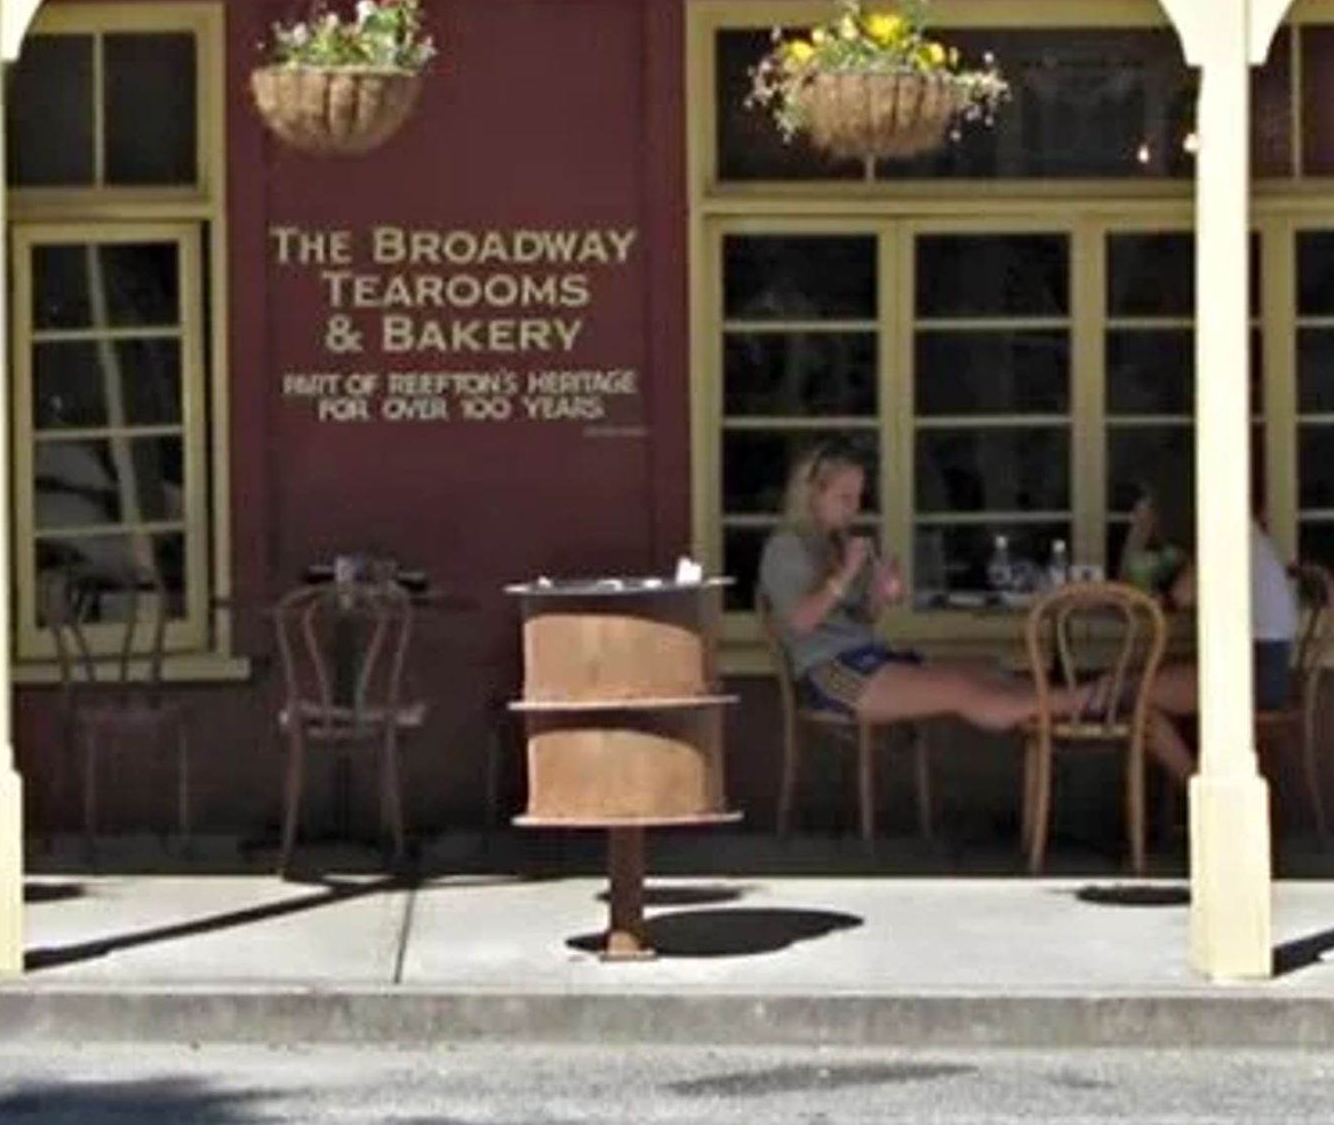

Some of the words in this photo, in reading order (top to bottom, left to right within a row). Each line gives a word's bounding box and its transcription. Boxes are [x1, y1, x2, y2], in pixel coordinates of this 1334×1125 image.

[271, 226, 352, 264] THE
[373, 226, 636, 265] BROADWAY
[321, 270, 591, 307] TEAROOMS
[325, 314, 363, 354] &
[382, 313, 583, 352] BAKERY
[283, 374, 341, 396] PART
[344, 373, 379, 396] OF
[527, 370, 637, 395] HERITAGE
[318, 397, 370, 421] FOR
[381, 397, 448, 421] OVER
[460, 397, 512, 420] 100
